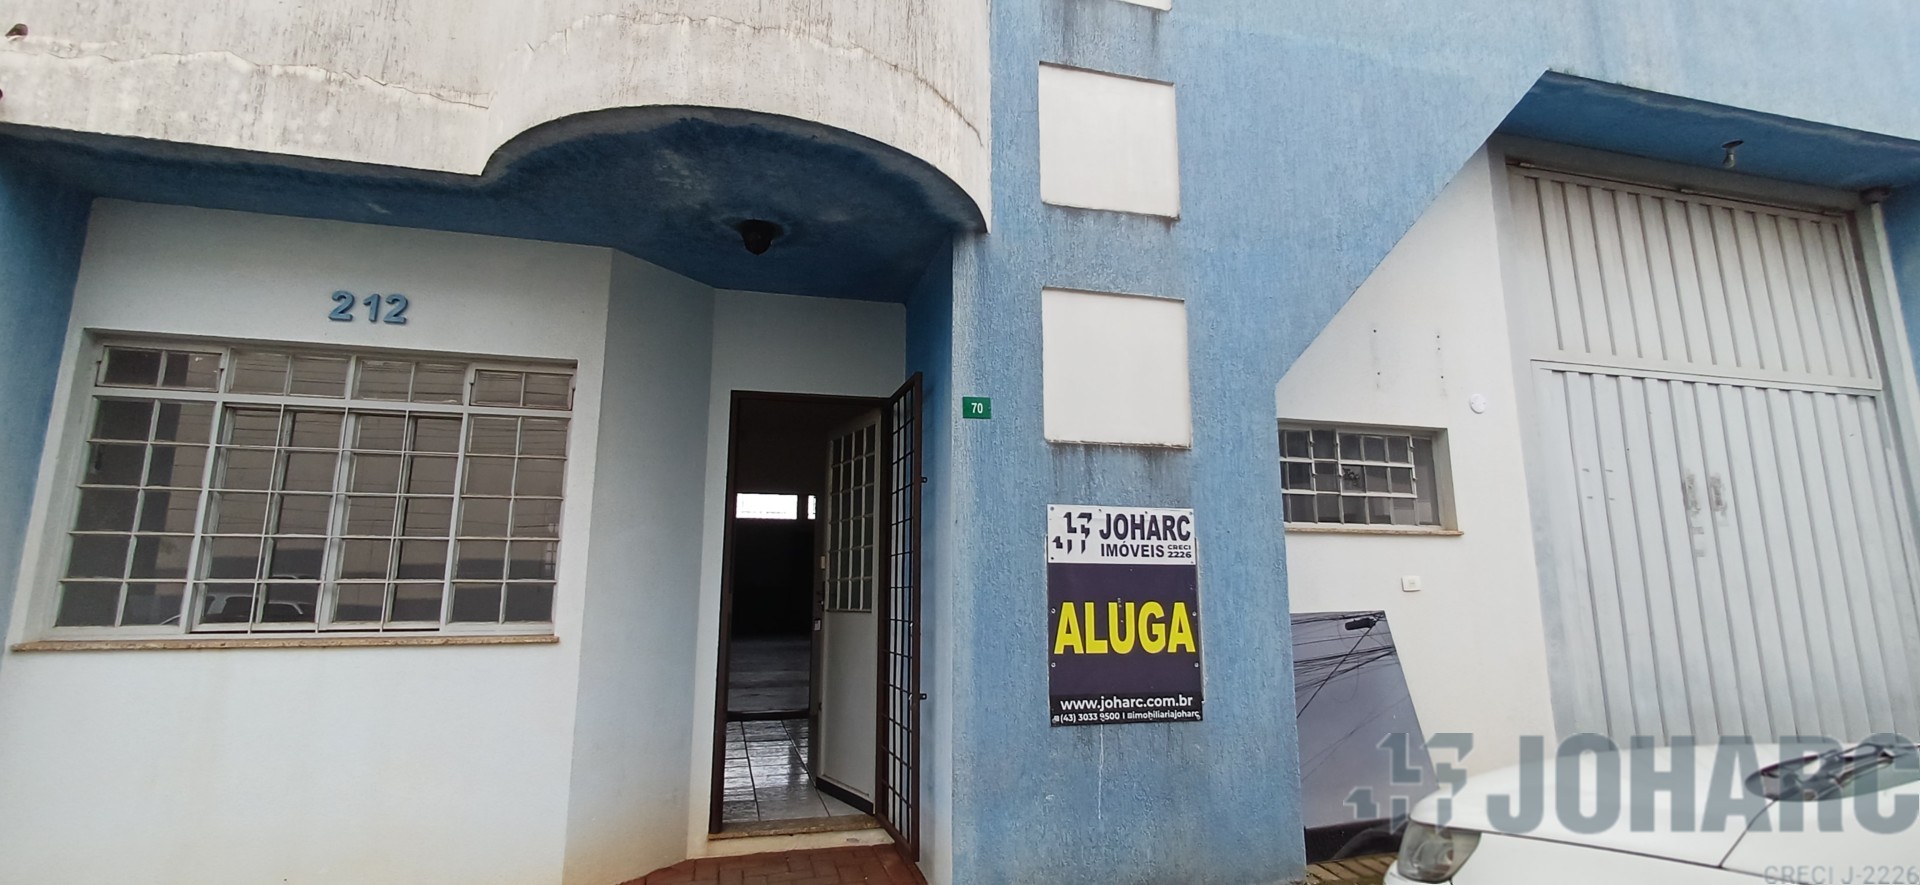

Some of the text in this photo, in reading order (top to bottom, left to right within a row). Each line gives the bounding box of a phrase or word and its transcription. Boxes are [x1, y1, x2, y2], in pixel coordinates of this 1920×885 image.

[328, 290, 409, 325] 212
[971, 402, 984, 414] 70
[1099, 513, 1191, 541] JOHARC
[1100, 541, 1165, 558] IMÓVEIS
[1054, 601, 1196, 655] ALUGA
[1060, 694, 1193, 711] www.joharc.com.br
[1060, 713, 1076, 724] (43)
[1078, 712, 1098, 721] 3033
[1099, 711, 1120, 721] 9500
